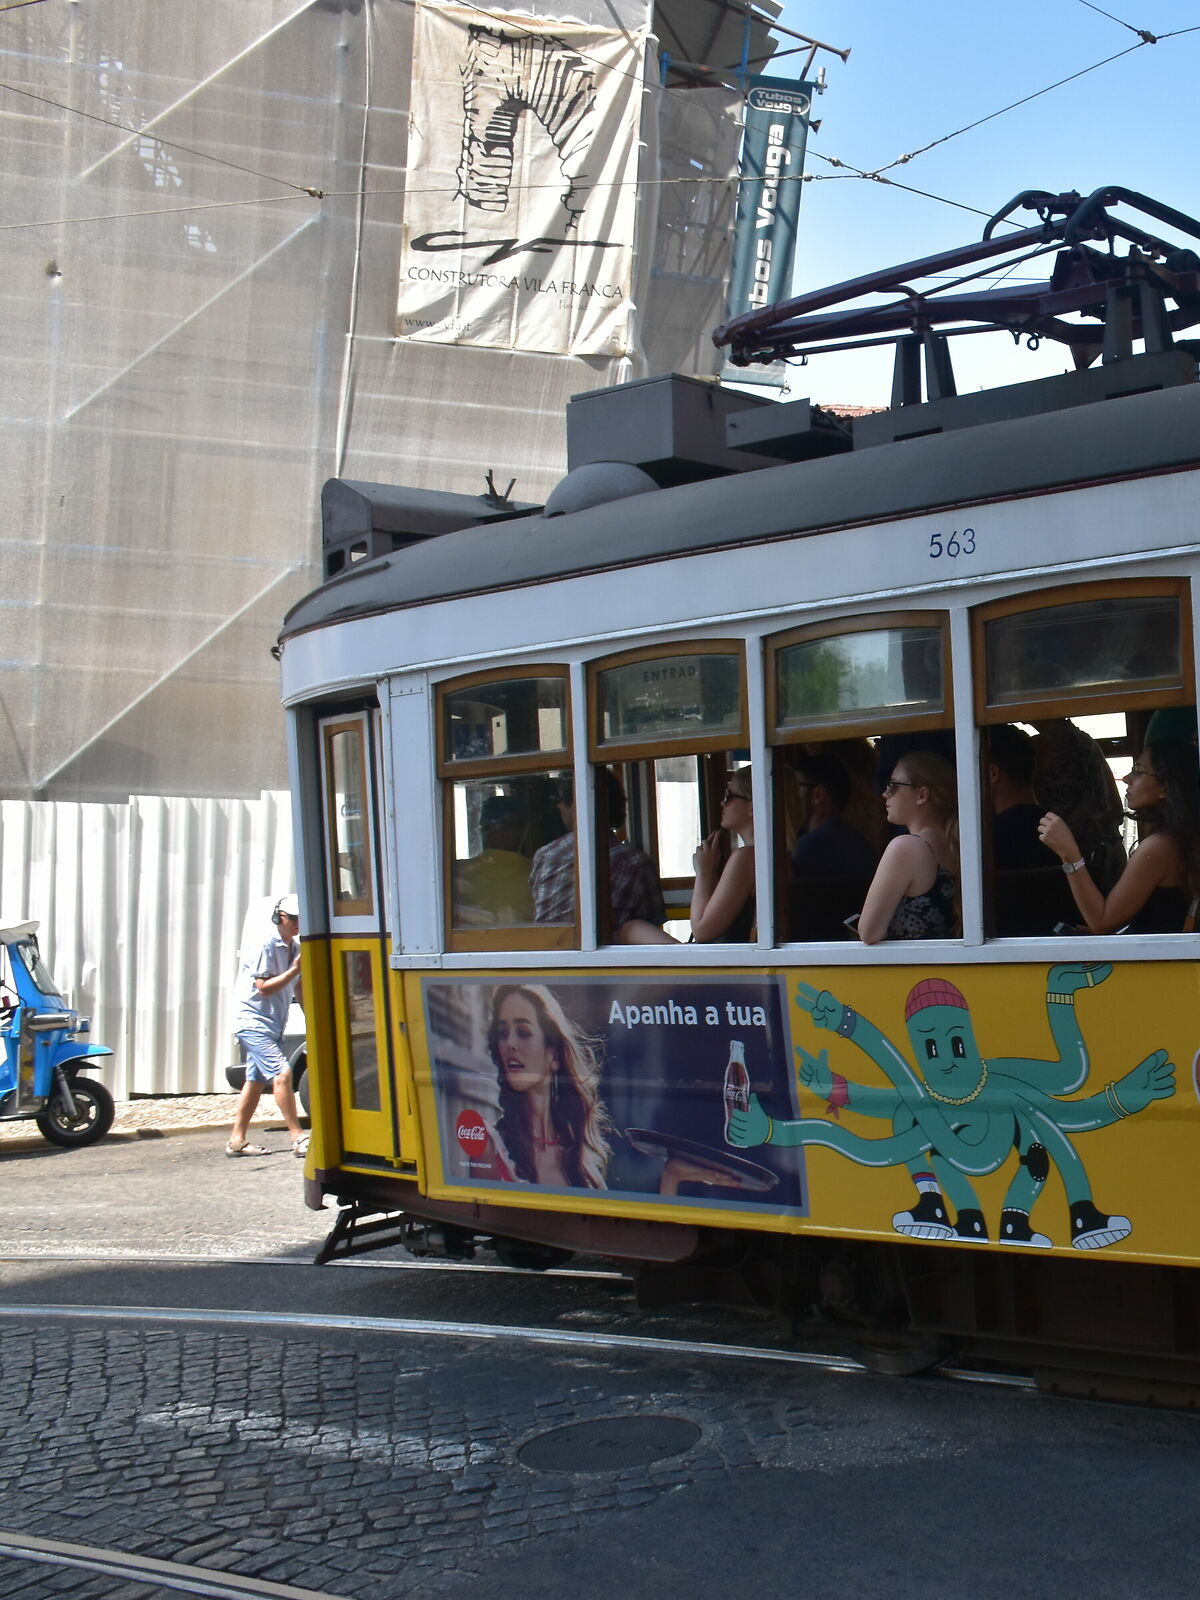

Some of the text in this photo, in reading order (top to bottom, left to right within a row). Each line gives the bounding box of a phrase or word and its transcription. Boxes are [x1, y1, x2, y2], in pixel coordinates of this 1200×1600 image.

[756, 98, 802, 113] Vouga
[757, 90, 802, 104] Tubos
[748, 123, 792, 310] bos Vouga
[407, 266, 623, 299] CONSTRUTORA VILA FRANCA
[929, 527, 976, 559] 563
[608, 999, 766, 1029] Apanha a tua
